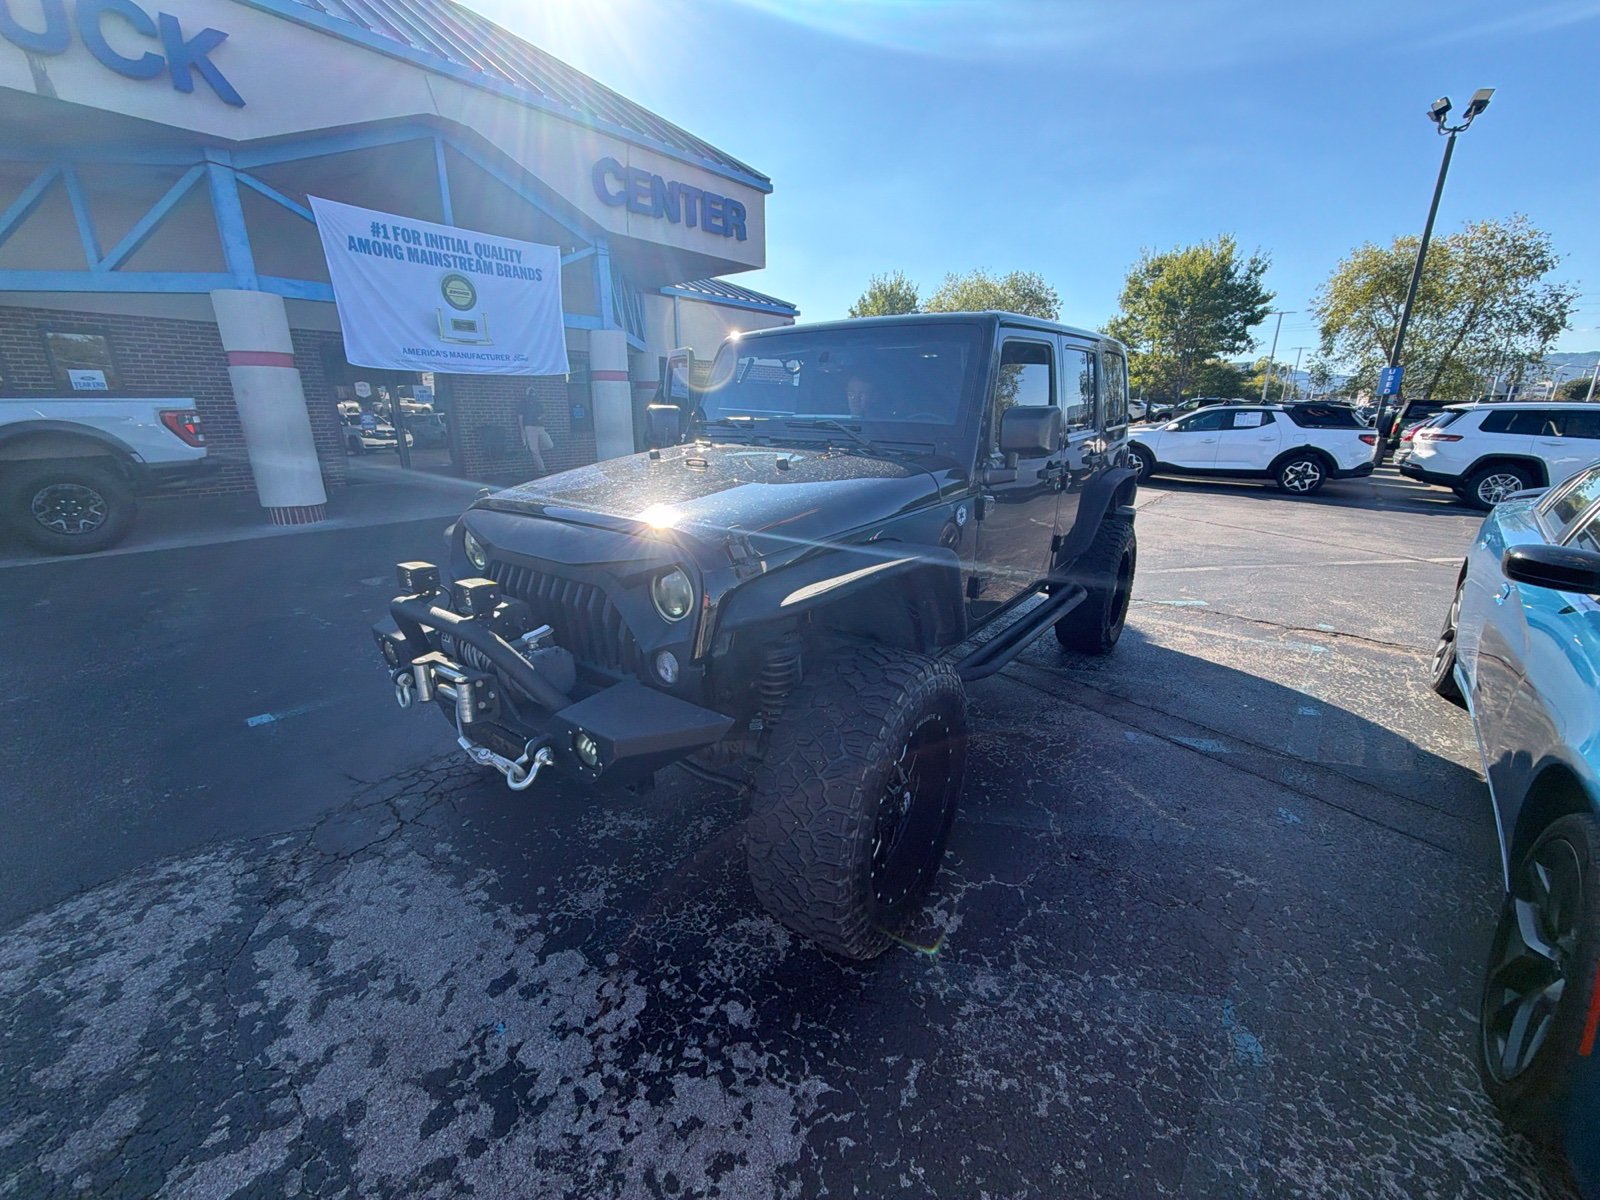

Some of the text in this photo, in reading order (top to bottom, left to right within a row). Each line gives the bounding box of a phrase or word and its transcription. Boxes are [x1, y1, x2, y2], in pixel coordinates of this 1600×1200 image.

[591, 156, 748, 242] CENTER
[347, 235, 543, 282] AMONG MAINSTREAM BRANDS
[370, 221, 522, 264] #1 FOR INITIAL QUALITY
[402, 347, 448, 358] AMERICA'S
[449, 351, 510, 361] MANUFACTURER
[1383, 368, 1397, 395] USED
